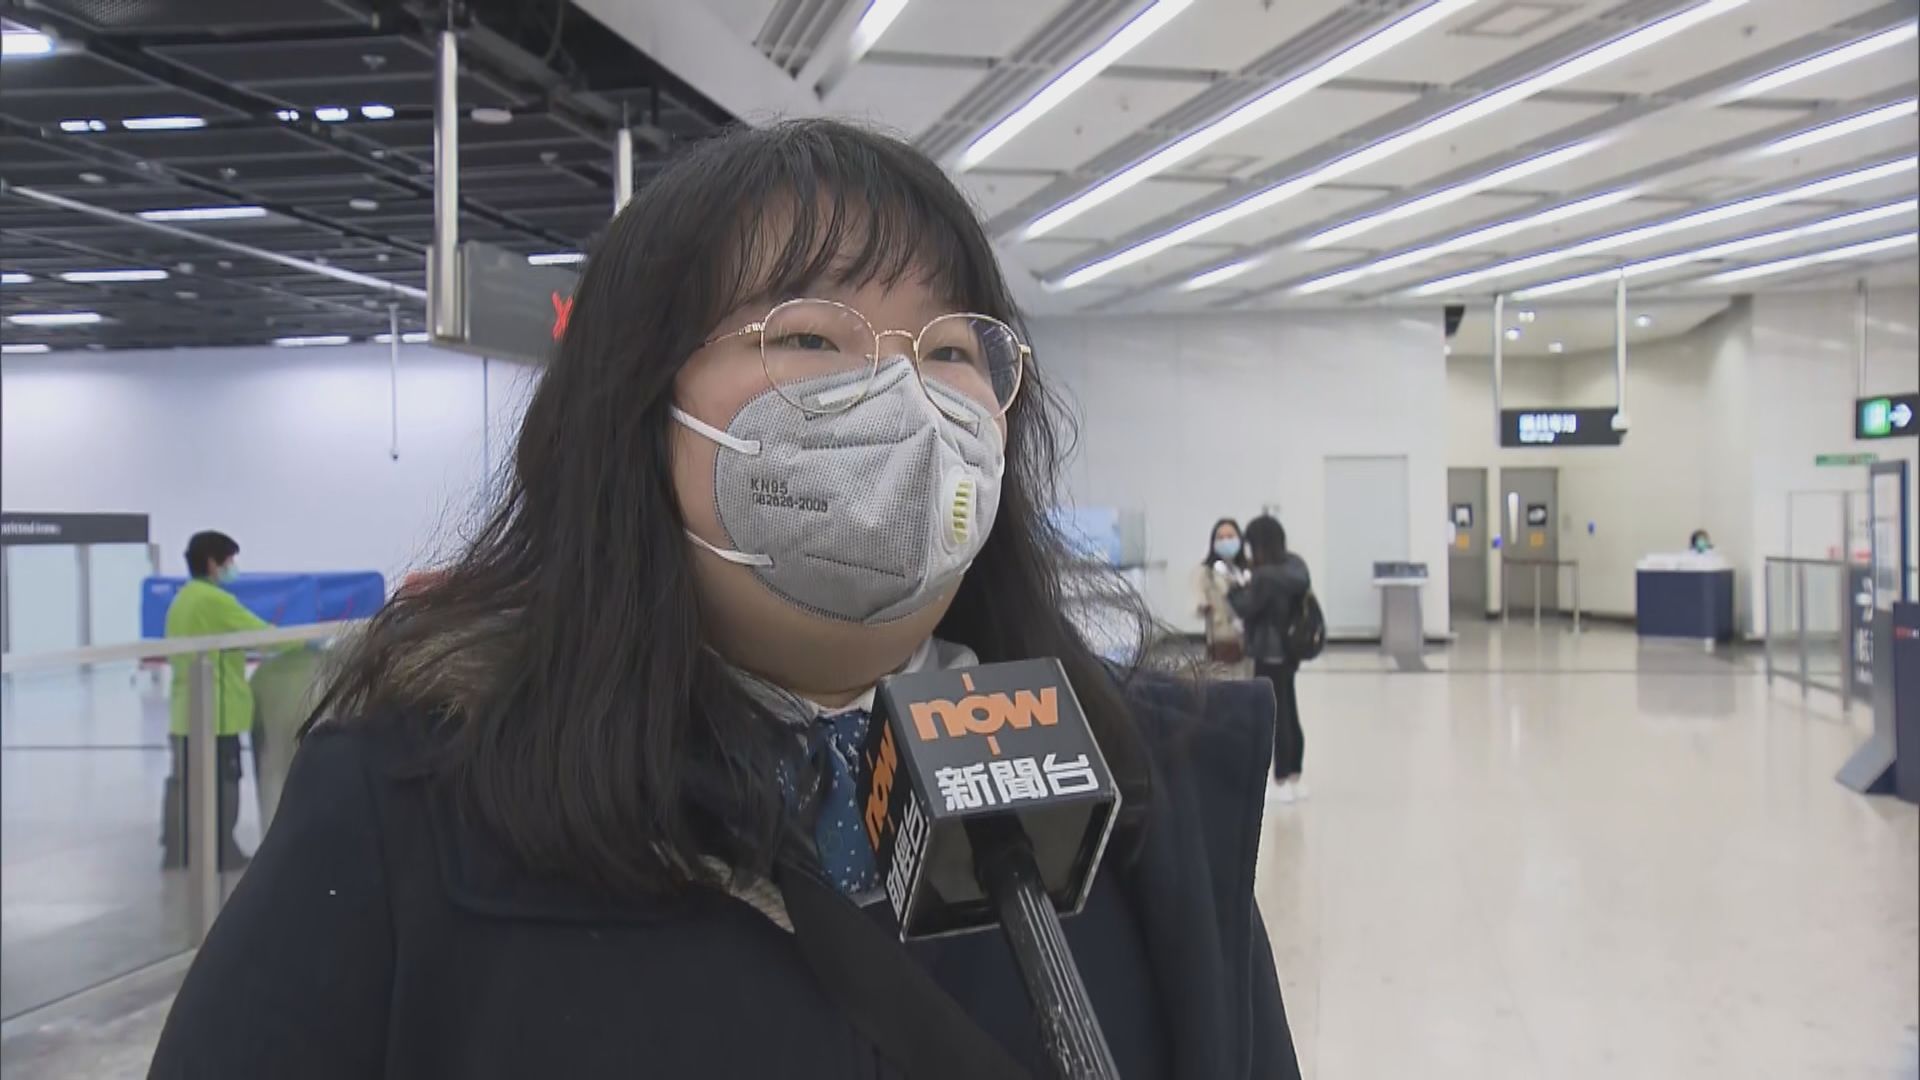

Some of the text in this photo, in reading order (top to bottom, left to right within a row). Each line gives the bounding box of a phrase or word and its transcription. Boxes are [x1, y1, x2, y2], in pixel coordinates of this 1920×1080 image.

[751, 478, 788, 494] KN95
[909, 686, 1059, 742] now
[865, 718, 898, 853] now
[935, 753, 1099, 811] 新聞台
[886, 788, 926, 922] 財經台
